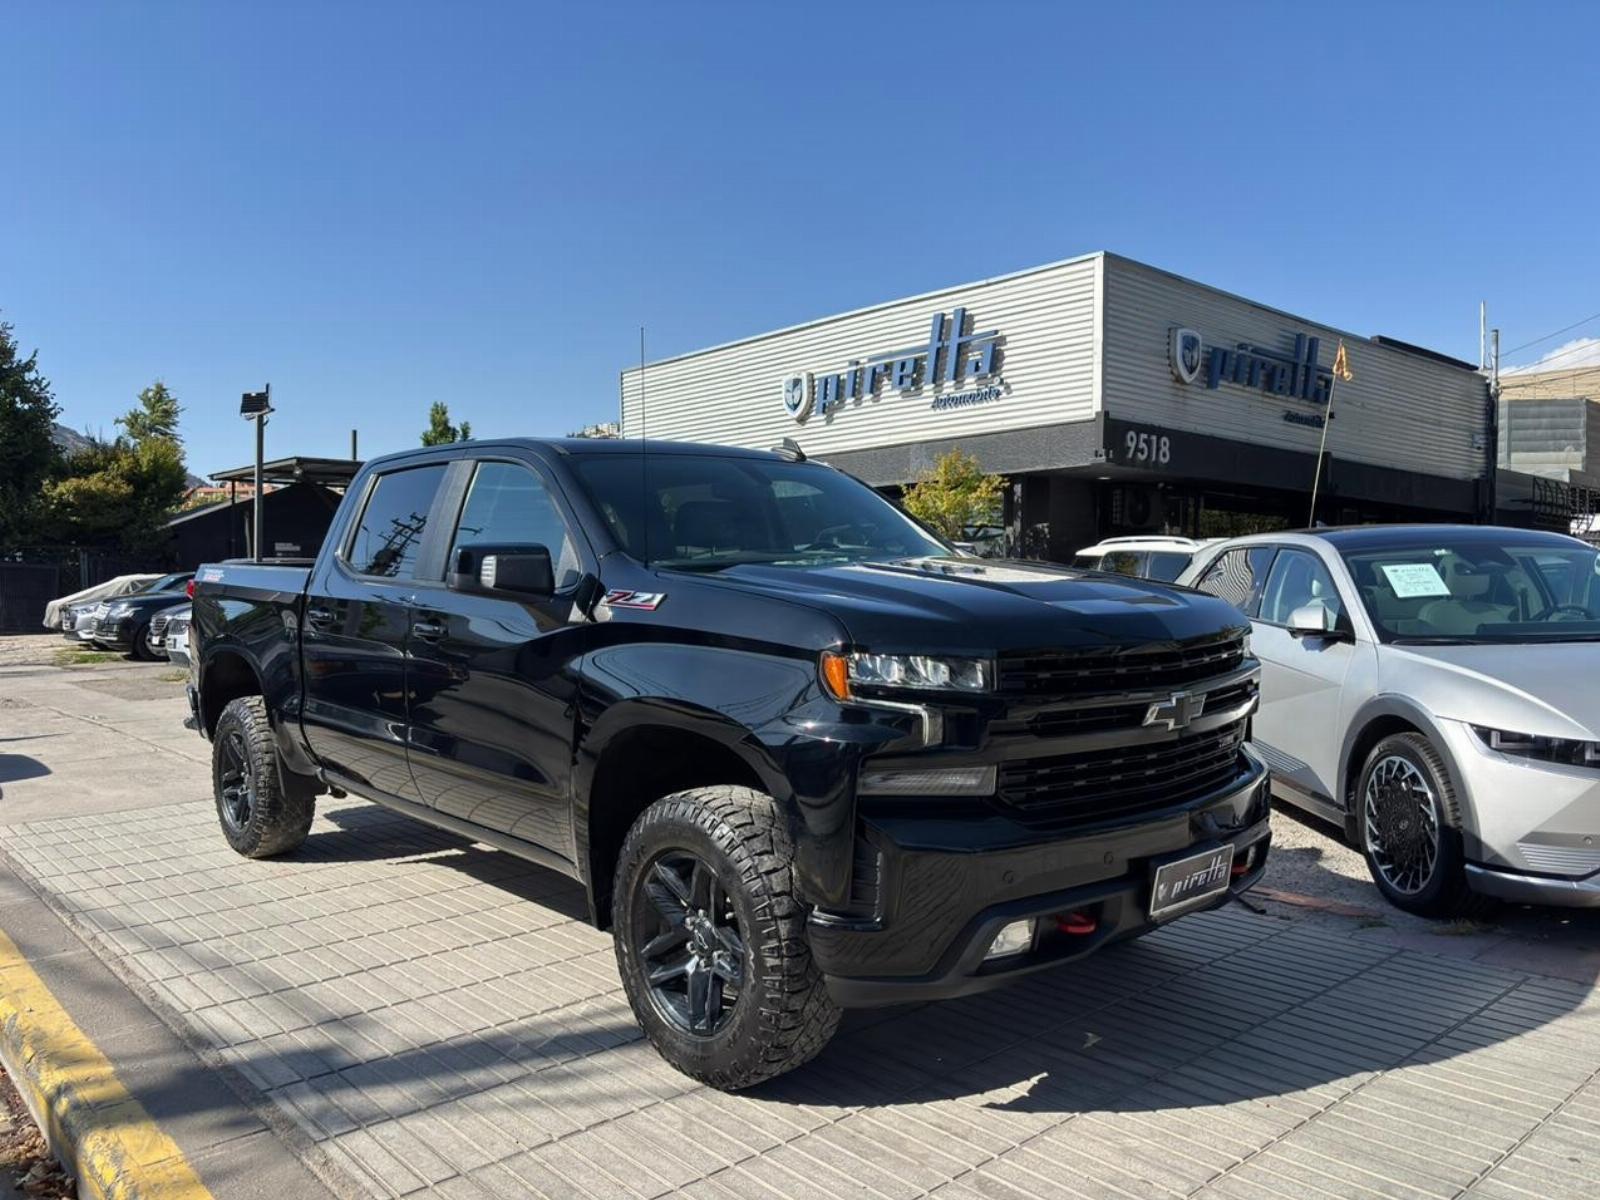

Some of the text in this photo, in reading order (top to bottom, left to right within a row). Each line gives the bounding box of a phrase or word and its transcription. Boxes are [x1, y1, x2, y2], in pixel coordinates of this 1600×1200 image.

[1125, 430, 1171, 464] 9518
[602, 588, 666, 610] Z71
[1170, 855, 1228, 899] piretta
